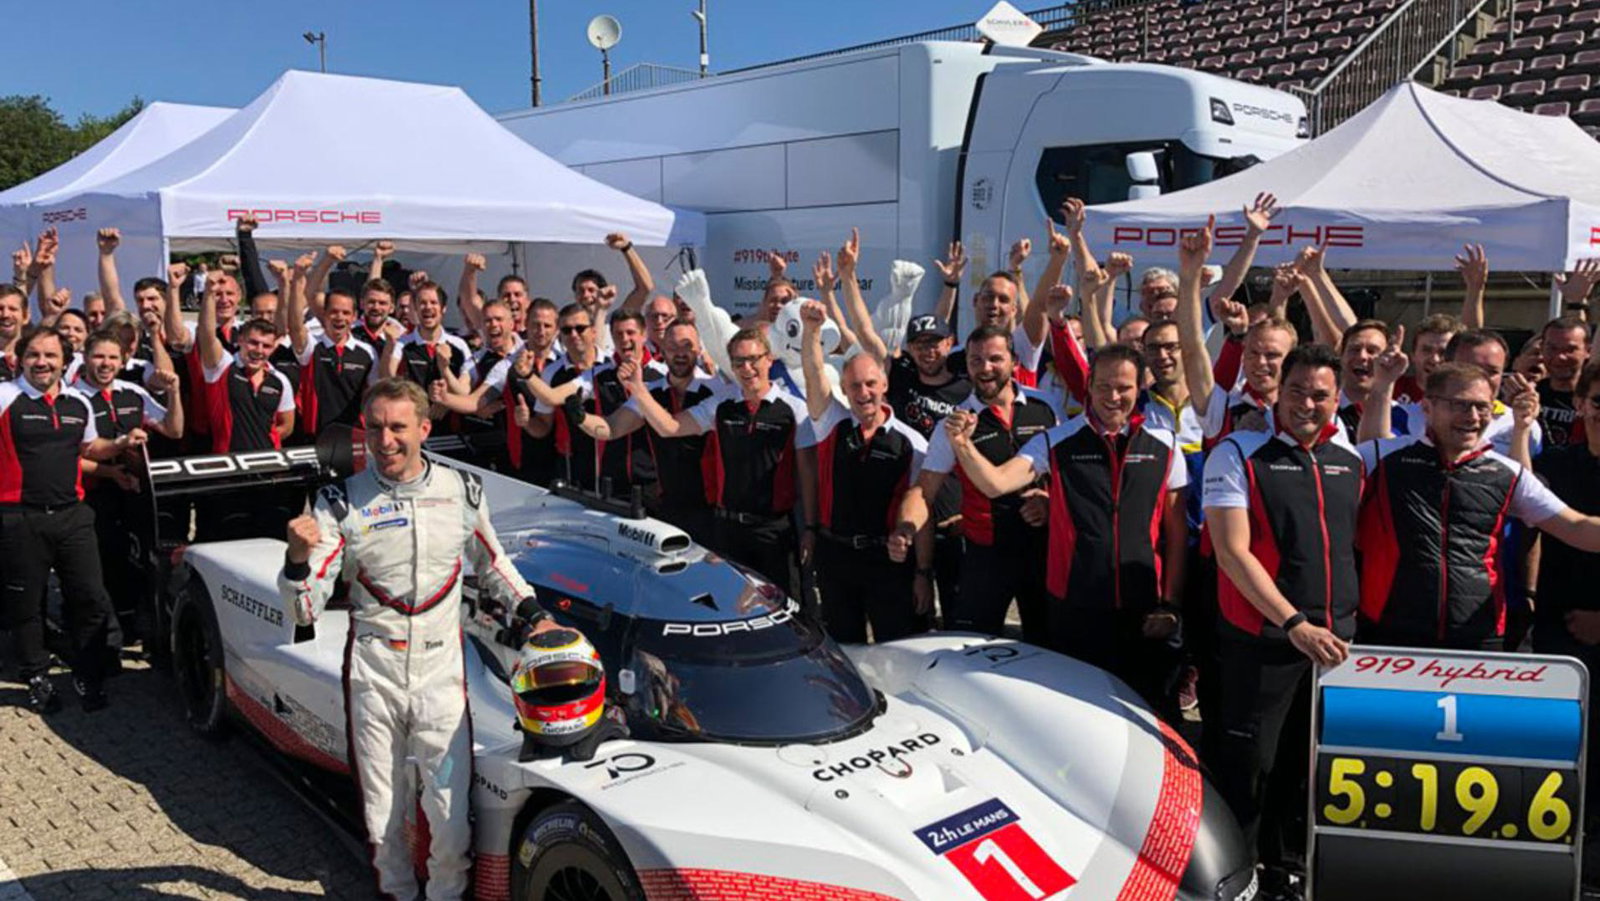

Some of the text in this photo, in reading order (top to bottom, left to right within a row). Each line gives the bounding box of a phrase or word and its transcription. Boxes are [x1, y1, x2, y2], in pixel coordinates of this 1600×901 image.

[1233, 103, 1293, 123] PORSCHE
[42, 207, 87, 224] PORSCHE
[227, 208, 381, 224] PORSCHE
[913, 315, 937, 332] YZ
[149, 448, 317, 476] PORS
[361, 503, 392, 517] Mobil
[221, 584, 284, 627] SCHAEFFLER
[662, 597, 800, 637] PORSCHE
[1355, 655, 1548, 688] 919 hybrid
[1436, 694, 1463, 742] 1
[812, 733, 941, 782] CHOPARD
[956, 823, 974, 837] LE
[973, 808, 1009, 830] MANS
[972, 838, 1046, 900] 1
